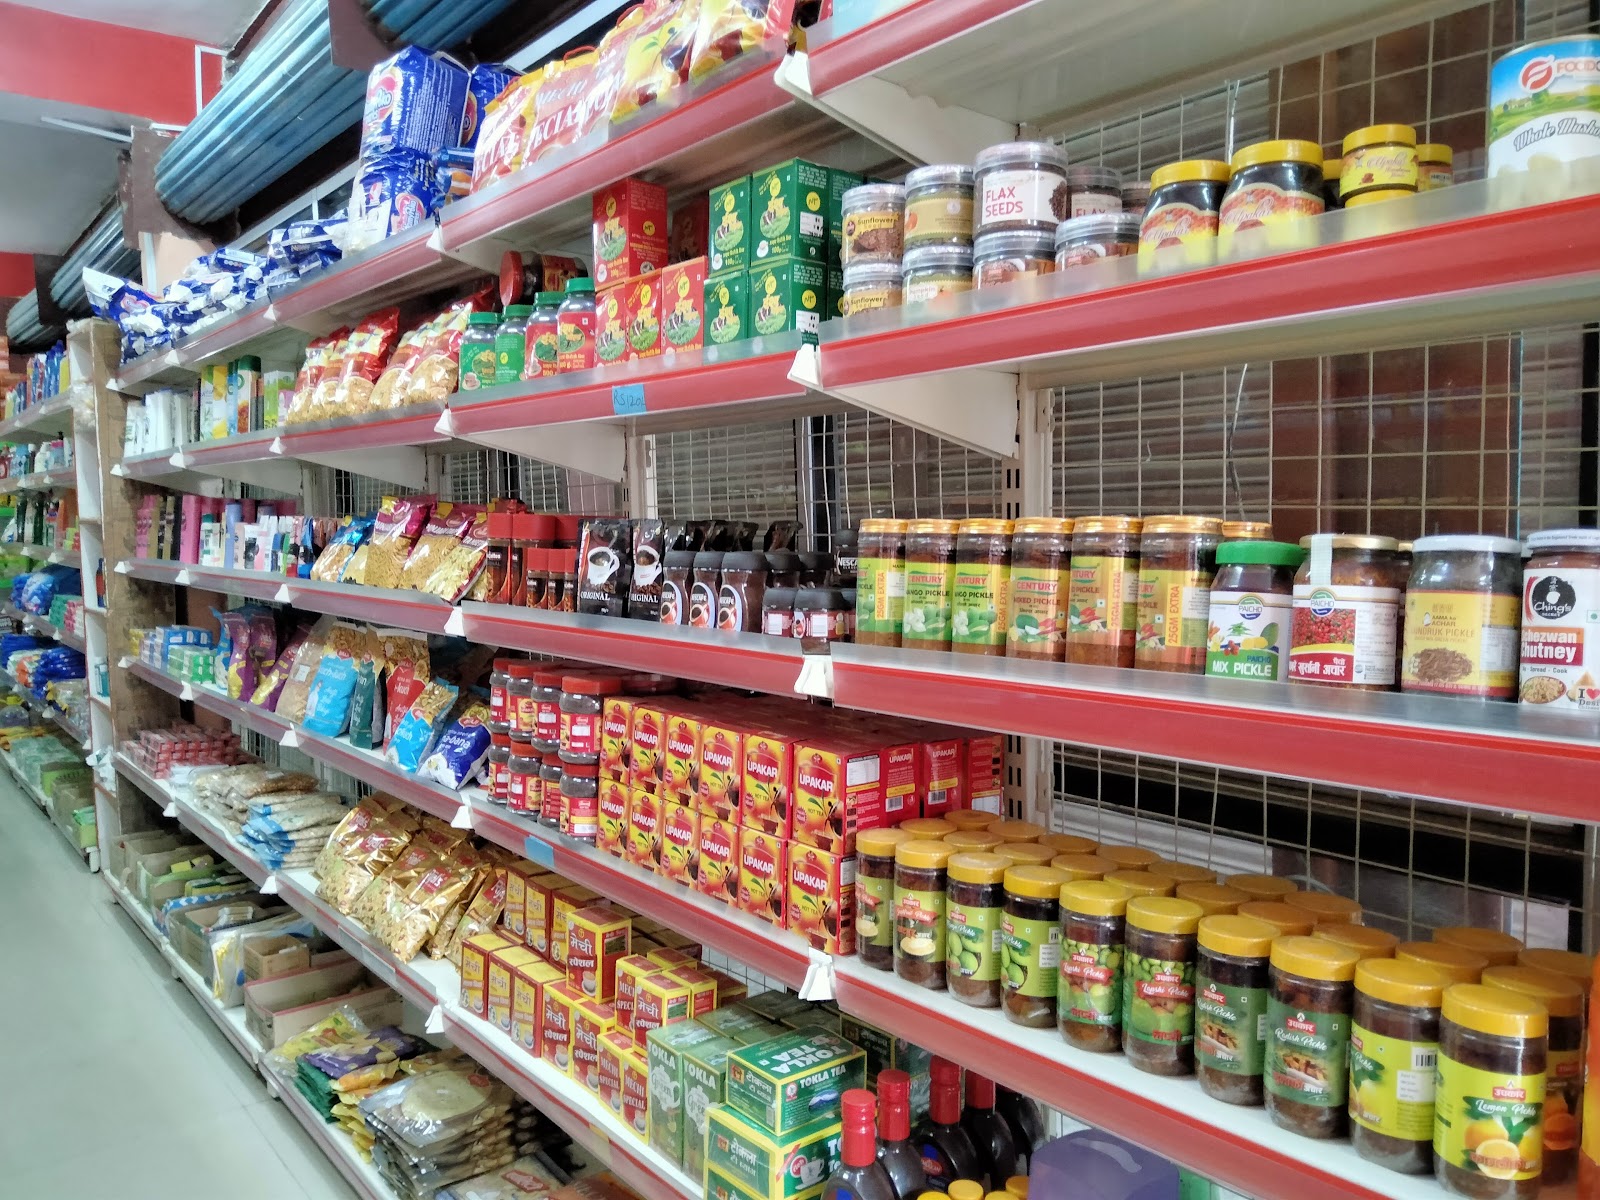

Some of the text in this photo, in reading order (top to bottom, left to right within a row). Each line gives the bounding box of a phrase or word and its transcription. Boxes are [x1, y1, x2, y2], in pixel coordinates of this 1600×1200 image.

[1514, 122, 1556, 152] Whole
[985, 186, 1016, 204] FLAX
[985, 201, 1024, 218] SEEDS
[858, 217, 894, 226] Sunflower
[850, 296, 883, 305] Sunflower
[838, 558, 858, 566] NESCA
[1000, 581, 1008, 605] EXTRA
[1016, 582, 1058, 591] CENTURY
[580, 591, 610, 601] ORIGINAL
[630, 592, 659, 603] RIGINAL
[1034, 597, 1060, 606] PICKLE
[1110, 572, 1122, 626] 25GM EXTRA
[1311, 599, 1335, 607] PAICHO
[1168, 585, 1180, 644] 25GM EXTRA
[1238, 605, 1262, 613] PAICHO
[1534, 601, 1572, 614] Ching's
[1446, 628, 1476, 638] PICKLE
[1246, 655, 1272, 664] PAICHO
[1212, 660, 1272, 676] MIX PICKLE
[1322, 664, 1347, 677] अचार
[1578, 688, 1586, 698] I
[1578, 698, 1600, 706] Desi
[604, 720, 626, 734] UPAKAR
[634, 730, 658, 744] UPAKAR
[668, 740, 694, 754] UPAKAR
[933, 749, 955, 758] UPAKAR
[704, 750, 732, 766] UPAKAR
[890, 754, 912, 764] UPAKAR
[748, 761, 778, 778] UPAKAR
[800, 773, 834, 792] UPAKAR
[601, 800, 624, 814] UPAKAR
[632, 812, 656, 828] UPAKAR
[666, 824, 692, 840] UPAKAR
[702, 838, 730, 858] UPAKAR
[744, 855, 774, 874] UPAKAR
[793, 870, 828, 890] UPAKAR
[570, 930, 593, 956] मेची
[1083, 968, 1106, 980] Pickle
[1168, 987, 1189, 998] Pickle
[616, 1000, 634, 1011] SPECI
[638, 996, 659, 1020] मेची
[1214, 1005, 1238, 1021] Pickle
[546, 1004, 566, 1030] मेची
[1288, 1019, 1315, 1032] उपकार
[1274, 1028, 1328, 1052] Radish Pickle
[648, 1040, 676, 1070] TOKLA
[770, 1046, 848, 1074] TOKLA
[771, 1044, 818, 1061] TEA
[600, 1056, 619, 1076] MECHI
[1354, 1051, 1374, 1071] Pickle
[599, 1074, 620, 1089] SPECIAL
[684, 1060, 716, 1090] TOKLA
[800, 1064, 846, 1089] TOKLA TEA
[625, 1074, 645, 1098] MECHI
[1494, 1088, 1526, 1098] उपकार
[623, 1094, 646, 1110] SPECIAL
[1476, 1100, 1537, 1117] Lemon Pickle
